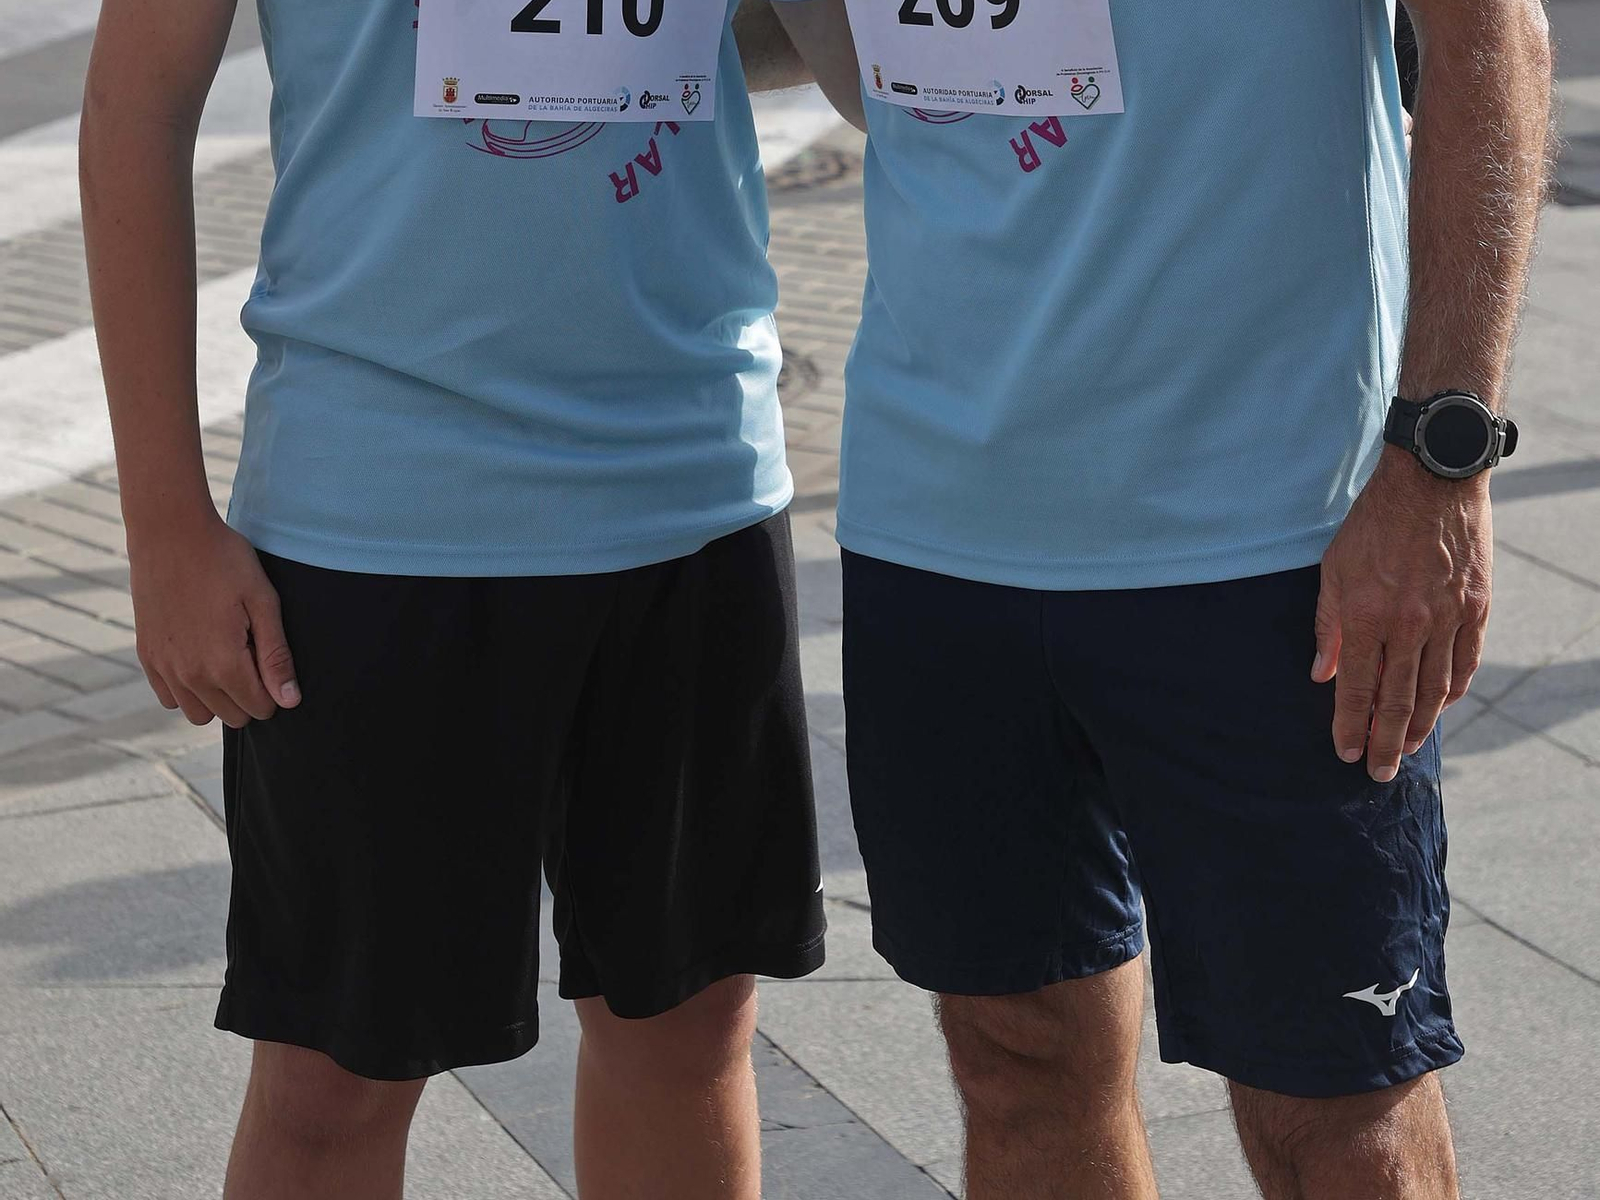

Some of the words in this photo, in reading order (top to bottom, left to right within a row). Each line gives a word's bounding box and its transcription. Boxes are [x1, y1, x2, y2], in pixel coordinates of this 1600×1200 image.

[923, 88, 957, 96] AUTORIDAD
[958, 90, 993, 98] PORTUARIA
[528, 96, 575, 104] AUTORIDAD
[577, 97, 618, 105] PORTUARIA
[549, 104, 572, 112] BAHÍA
